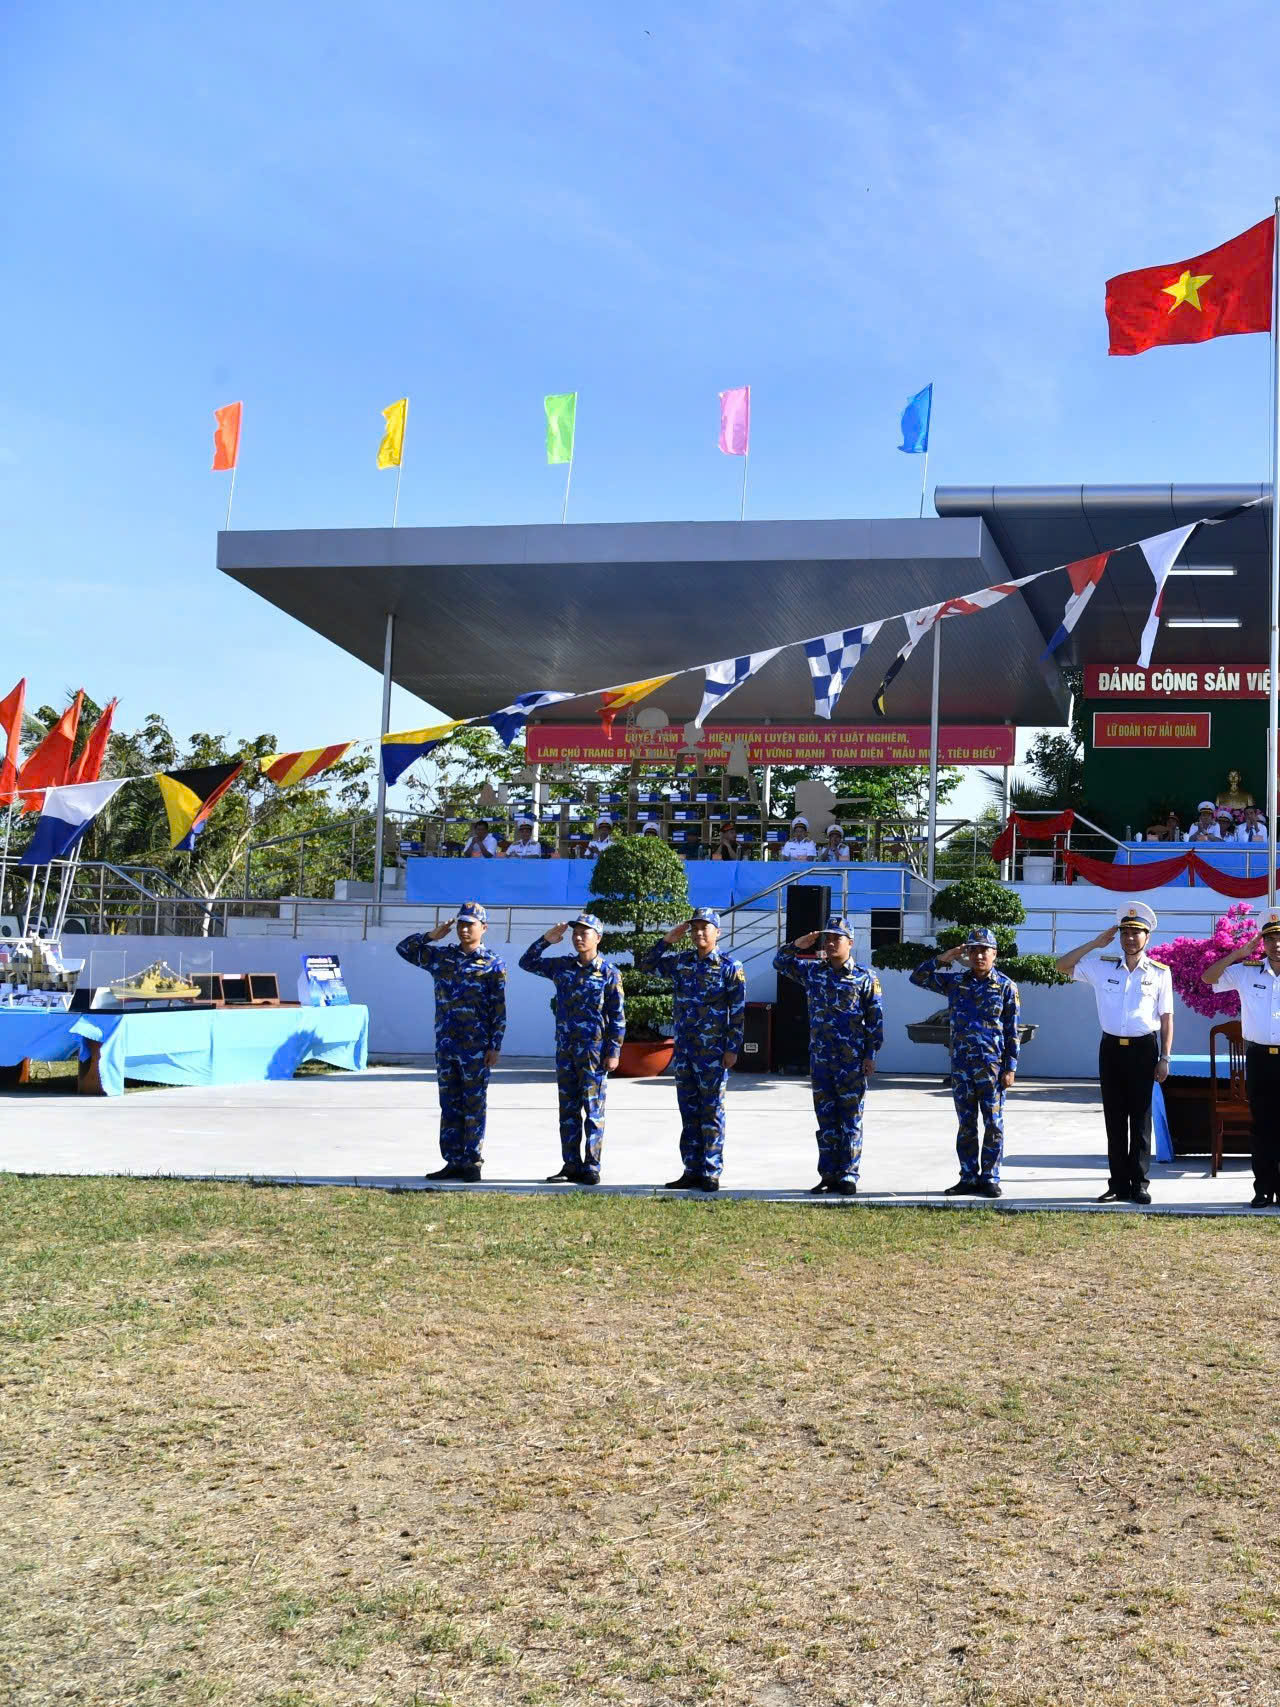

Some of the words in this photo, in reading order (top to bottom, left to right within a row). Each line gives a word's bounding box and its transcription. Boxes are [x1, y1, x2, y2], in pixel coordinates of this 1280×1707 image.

[1099, 667, 1145, 691] ĐẢNG
[1152, 668, 1197, 694] CỘNG
[1204, 667, 1240, 691] SẢN
[1119, 723, 1140, 737] ĐOÀN
[1143, 725, 1157, 737] 167
[1159, 722, 1172, 737] HẢI
[1175, 723, 1196, 738] QUÂN
[764, 732, 795, 744] LUYỆN
[867, 732, 910, 744] NGHIÊM,
[538, 746, 558, 757] LÀM
[561, 745, 580, 757] CHỦ
[583, 748, 614, 757] TRANG
[617, 748, 626, 759] BỊ
[796, 749, 825, 760] MẠNH
[832, 747, 857, 758] TOÀN
[860, 747, 883, 760] DIỆN
[948, 747, 969, 758] TIÊU
